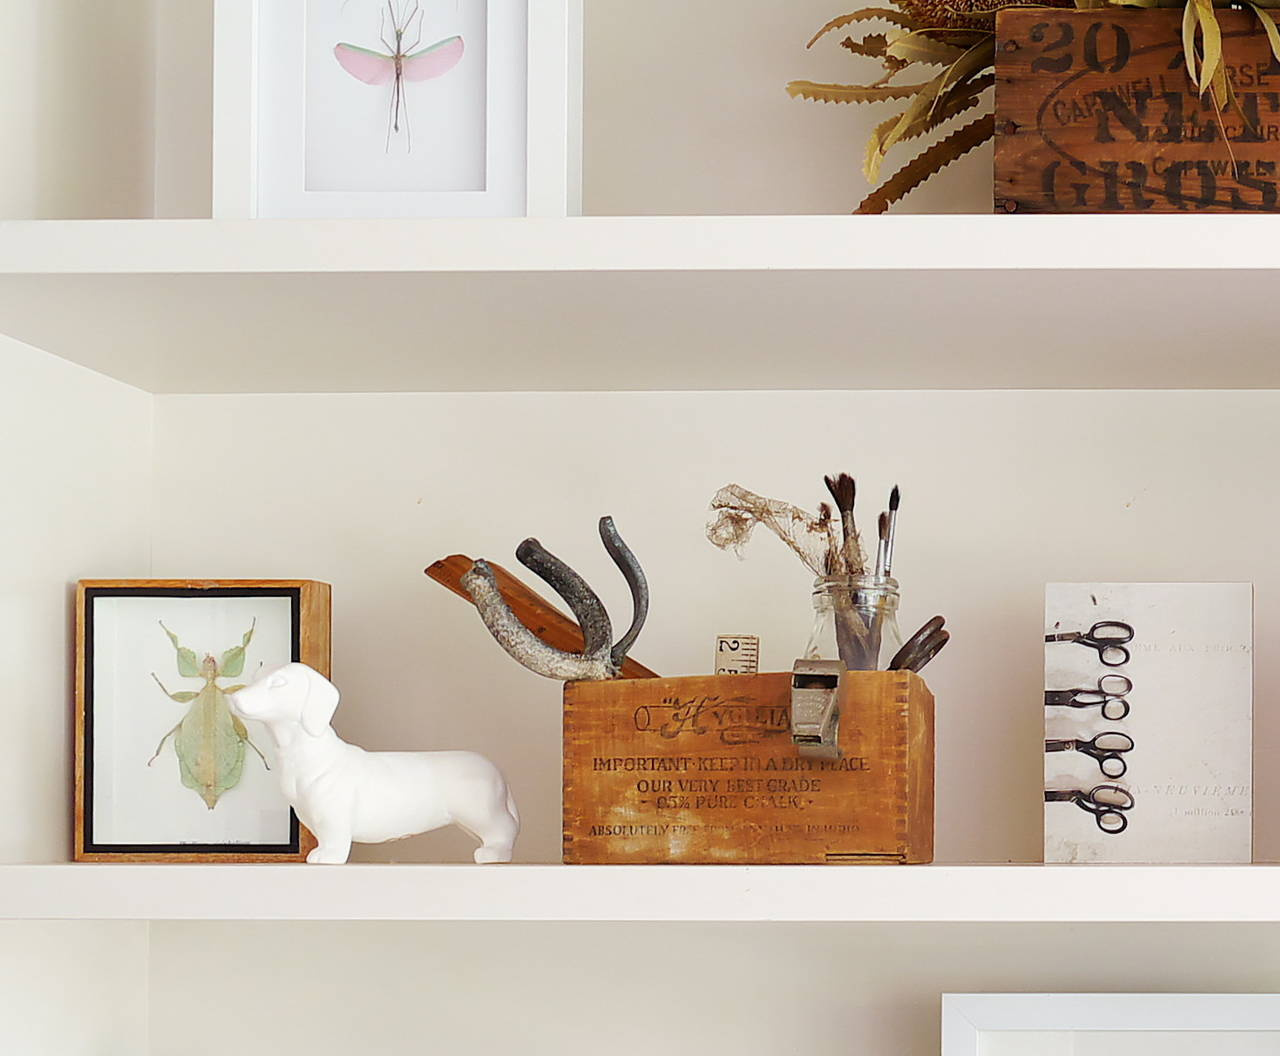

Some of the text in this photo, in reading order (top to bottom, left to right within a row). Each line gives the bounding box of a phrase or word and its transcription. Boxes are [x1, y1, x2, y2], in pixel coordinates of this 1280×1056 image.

[1029, 22, 1130, 73] 20
[718, 639, 740, 653] 2
[592, 757, 692, 772] IMPORTANT
[636, 778, 673, 794] OUR
[677, 778, 720, 793] VERY
[589, 824, 670, 837] ABSOLUTELY
